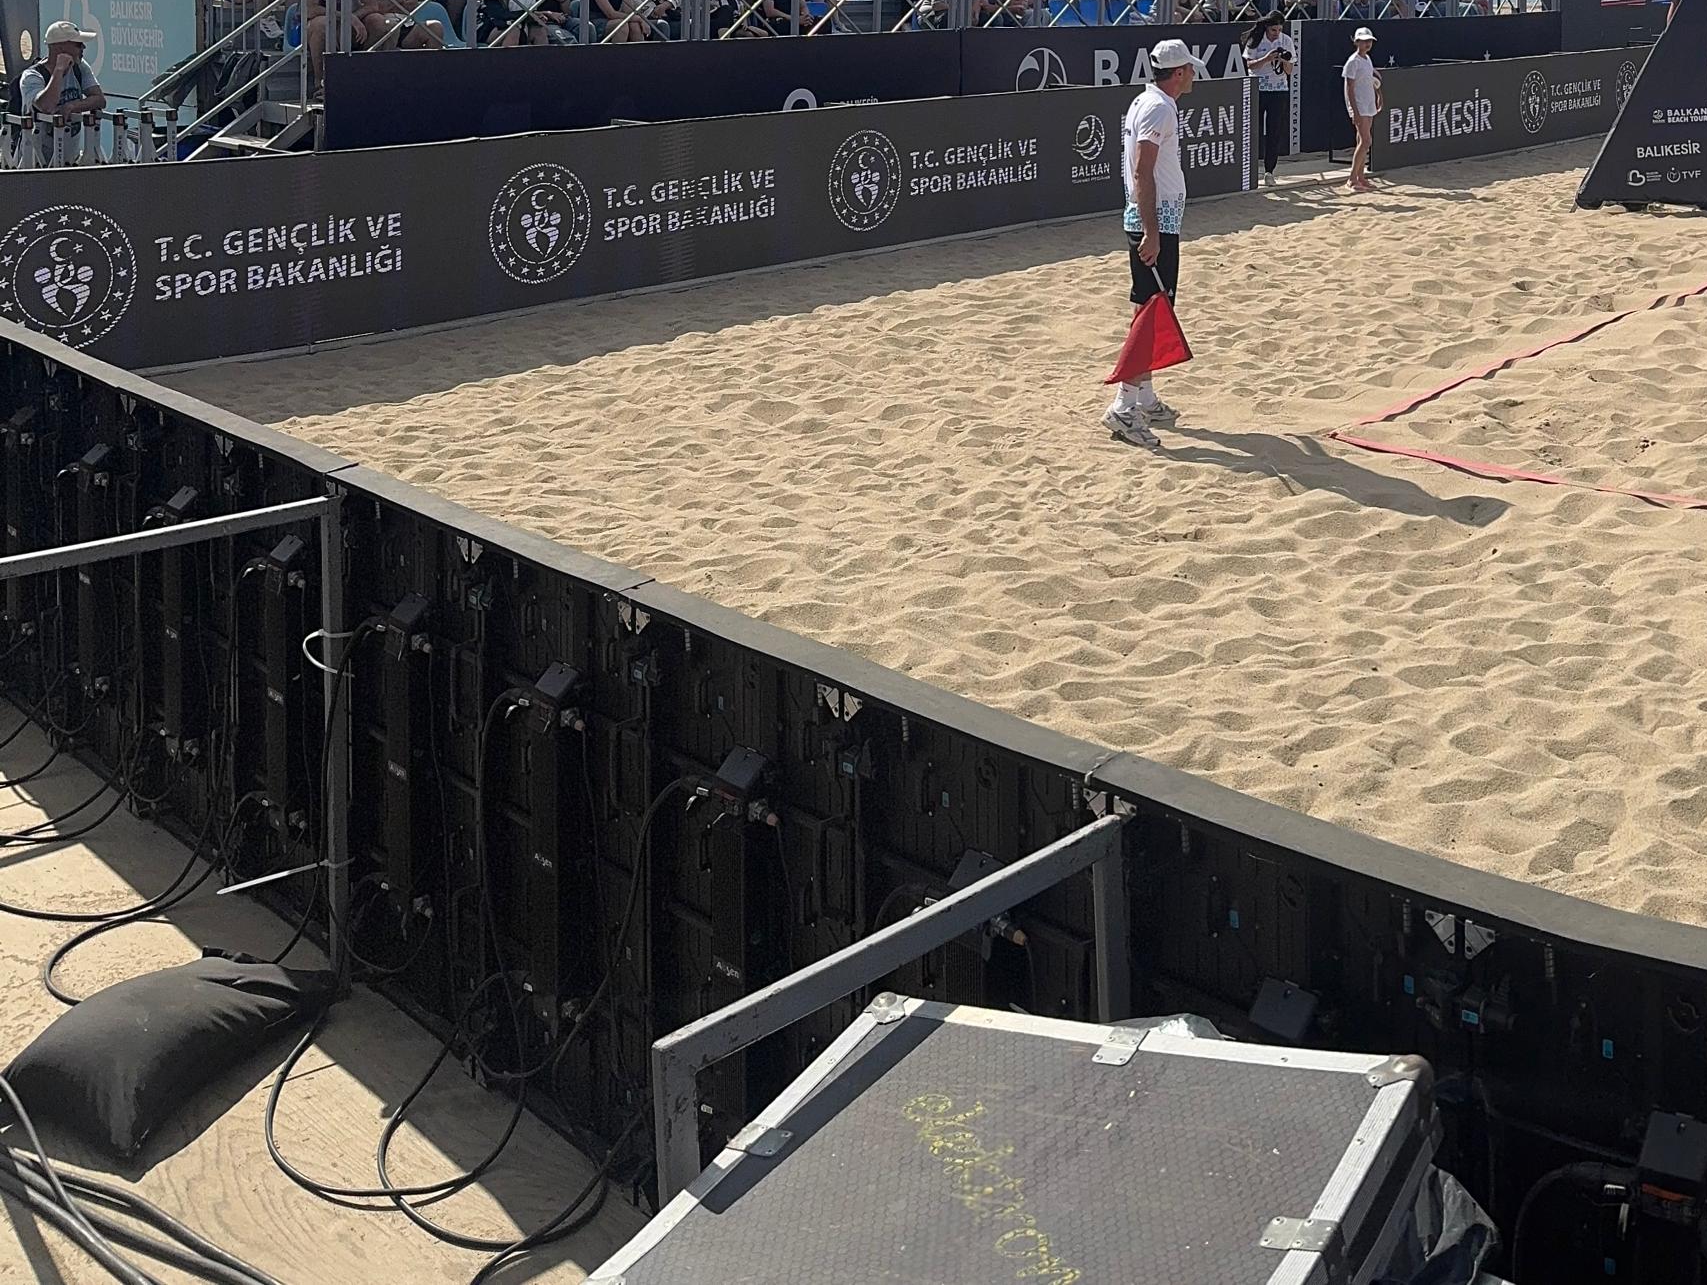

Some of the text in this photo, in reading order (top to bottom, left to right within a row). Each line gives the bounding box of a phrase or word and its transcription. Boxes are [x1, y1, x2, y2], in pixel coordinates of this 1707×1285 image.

[110, 22, 165, 51] BÜYÜKŞEHİR
[111, 52, 159, 76] BELEDİYESİ
[1564, 77, 1593, 96] GENÇLİK
[1592, 79, 1601, 92] VE
[1389, 88, 1493, 144] BALIKESİR
[1551, 92, 1601, 113] SPOR BAKANLIĞI
[1667, 107, 1707, 117] BALKAN
[909, 137, 1037, 170] T.C. GENÇLİK VE
[1187, 139, 1235, 169] TOUR
[1636, 139, 1701, 159] BALIKESİR
[910, 160, 1037, 196] SPOR BAKANLIĞI
[1071, 162, 1111, 179] BALKAN
[1681, 170, 1702, 179] TVF
[602, 168, 775, 209] T.C. GENÇLİK VE
[603, 194, 775, 241] SPOR BAKANLIĞI
[154, 212, 402, 263] T.C. GENÇLİK VE
[154, 244, 402, 301] SPOR BAKANLIĞI
